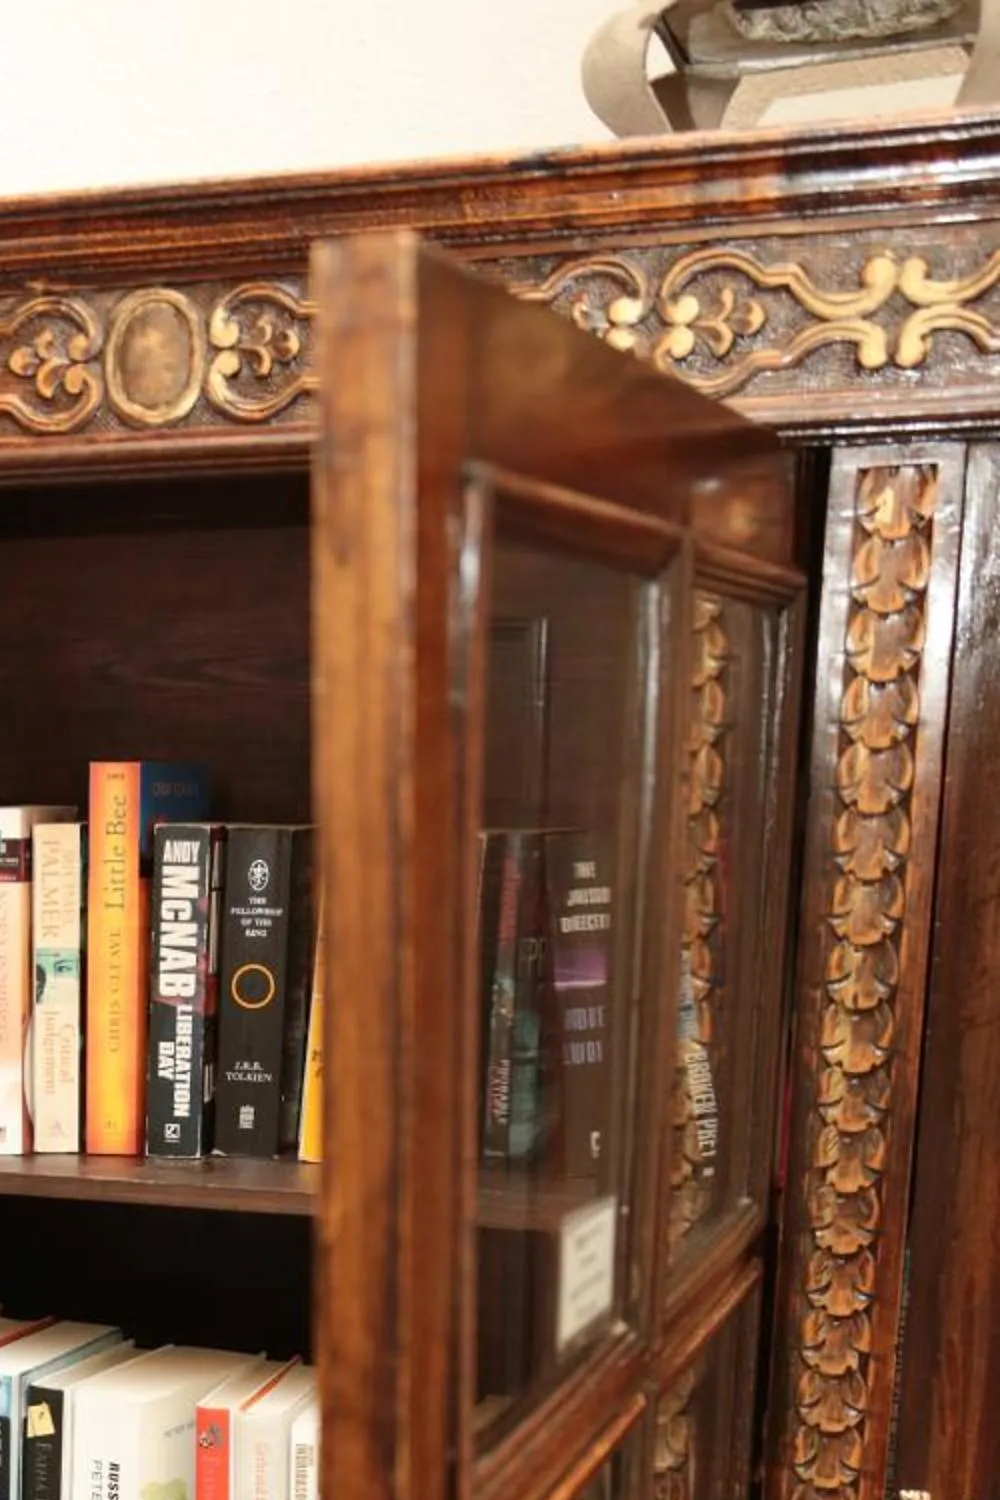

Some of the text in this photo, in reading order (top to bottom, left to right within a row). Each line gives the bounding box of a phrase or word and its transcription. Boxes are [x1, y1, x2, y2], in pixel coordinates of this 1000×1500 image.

[105, 794, 128, 836] Bee
[162, 839, 200, 863] ANDY
[40, 838, 62, 939] PALMER
[102, 847, 128, 912] Little
[230, 905, 284, 917] FELLOWSHIP
[249, 896, 267, 905] THE
[158, 865, 201, 997] McNAB
[241, 918, 272, 927] OF THE
[108, 1000, 121, 1054] CHRIS
[157, 1041, 176, 1080] DAY
[172, 1004, 195, 1118] LIBERATION
[226, 1071, 273, 1084] TOLKIEN
